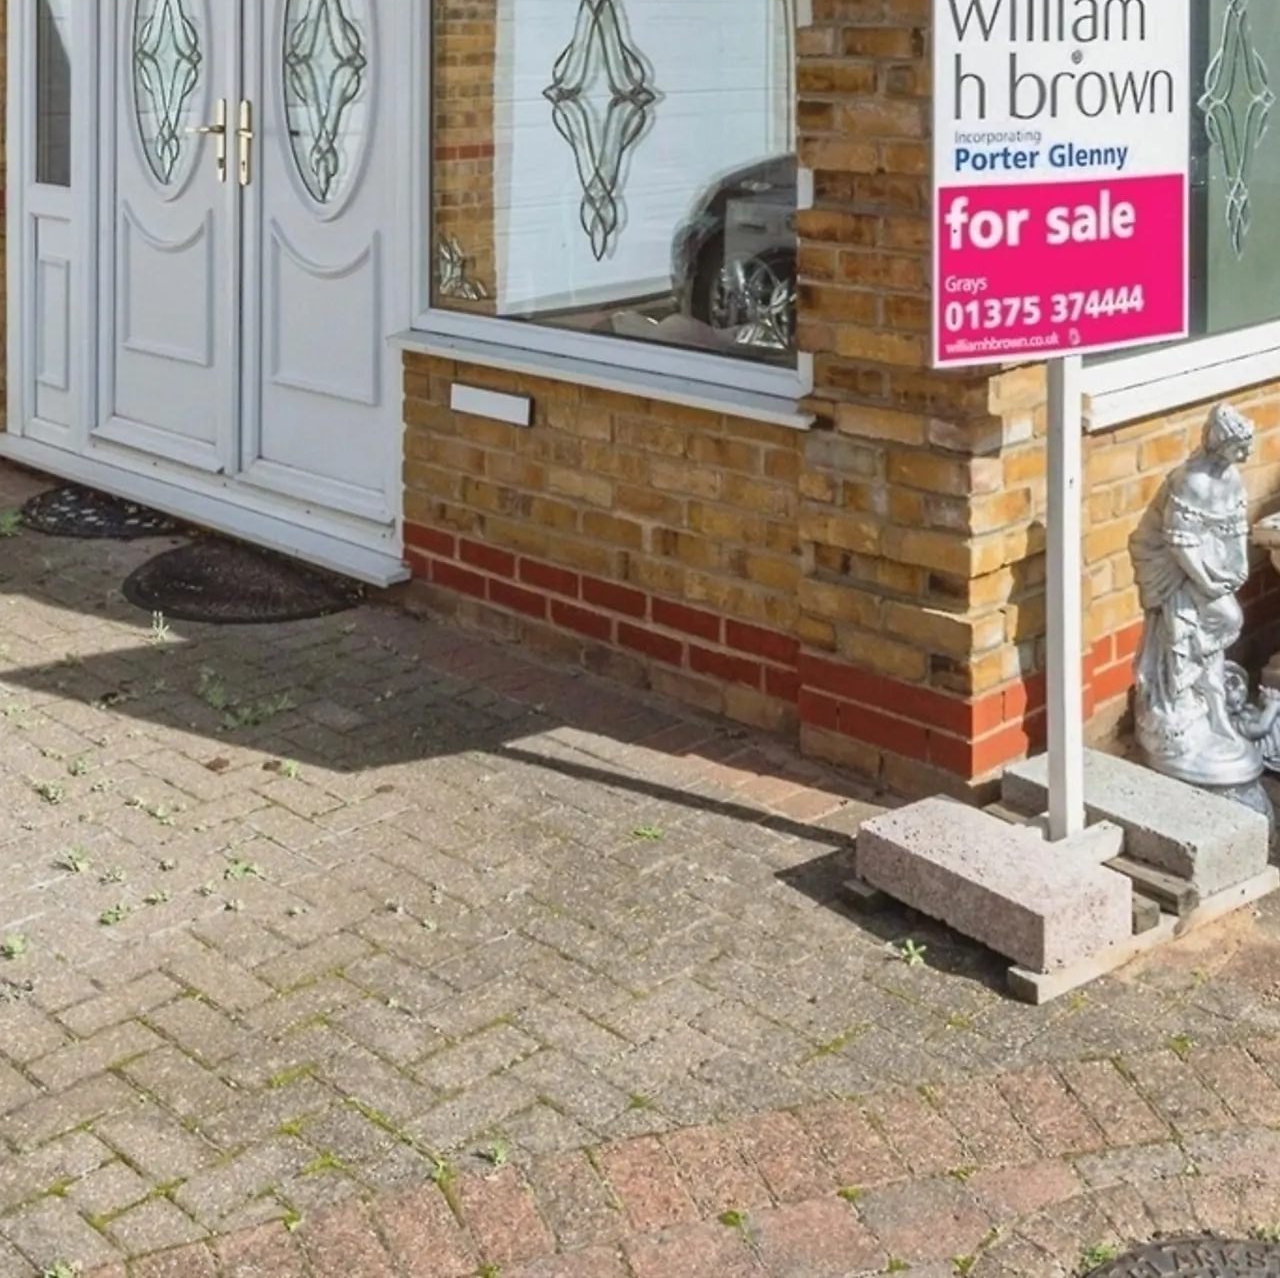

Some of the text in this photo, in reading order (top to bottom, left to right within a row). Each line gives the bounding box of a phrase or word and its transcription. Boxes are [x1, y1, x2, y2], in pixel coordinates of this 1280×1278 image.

[954, 52, 1173, 120] h brown
[954, 130, 1042, 145] Incorporating
[954, 143, 1129, 172] Porter Glenny
[945, 189, 1136, 250] for sale
[945, 275, 988, 295] Grays
[945, 284, 1144, 331] 01375 374444
[945, 332, 1059, 354] williamhbrown.co.uk
